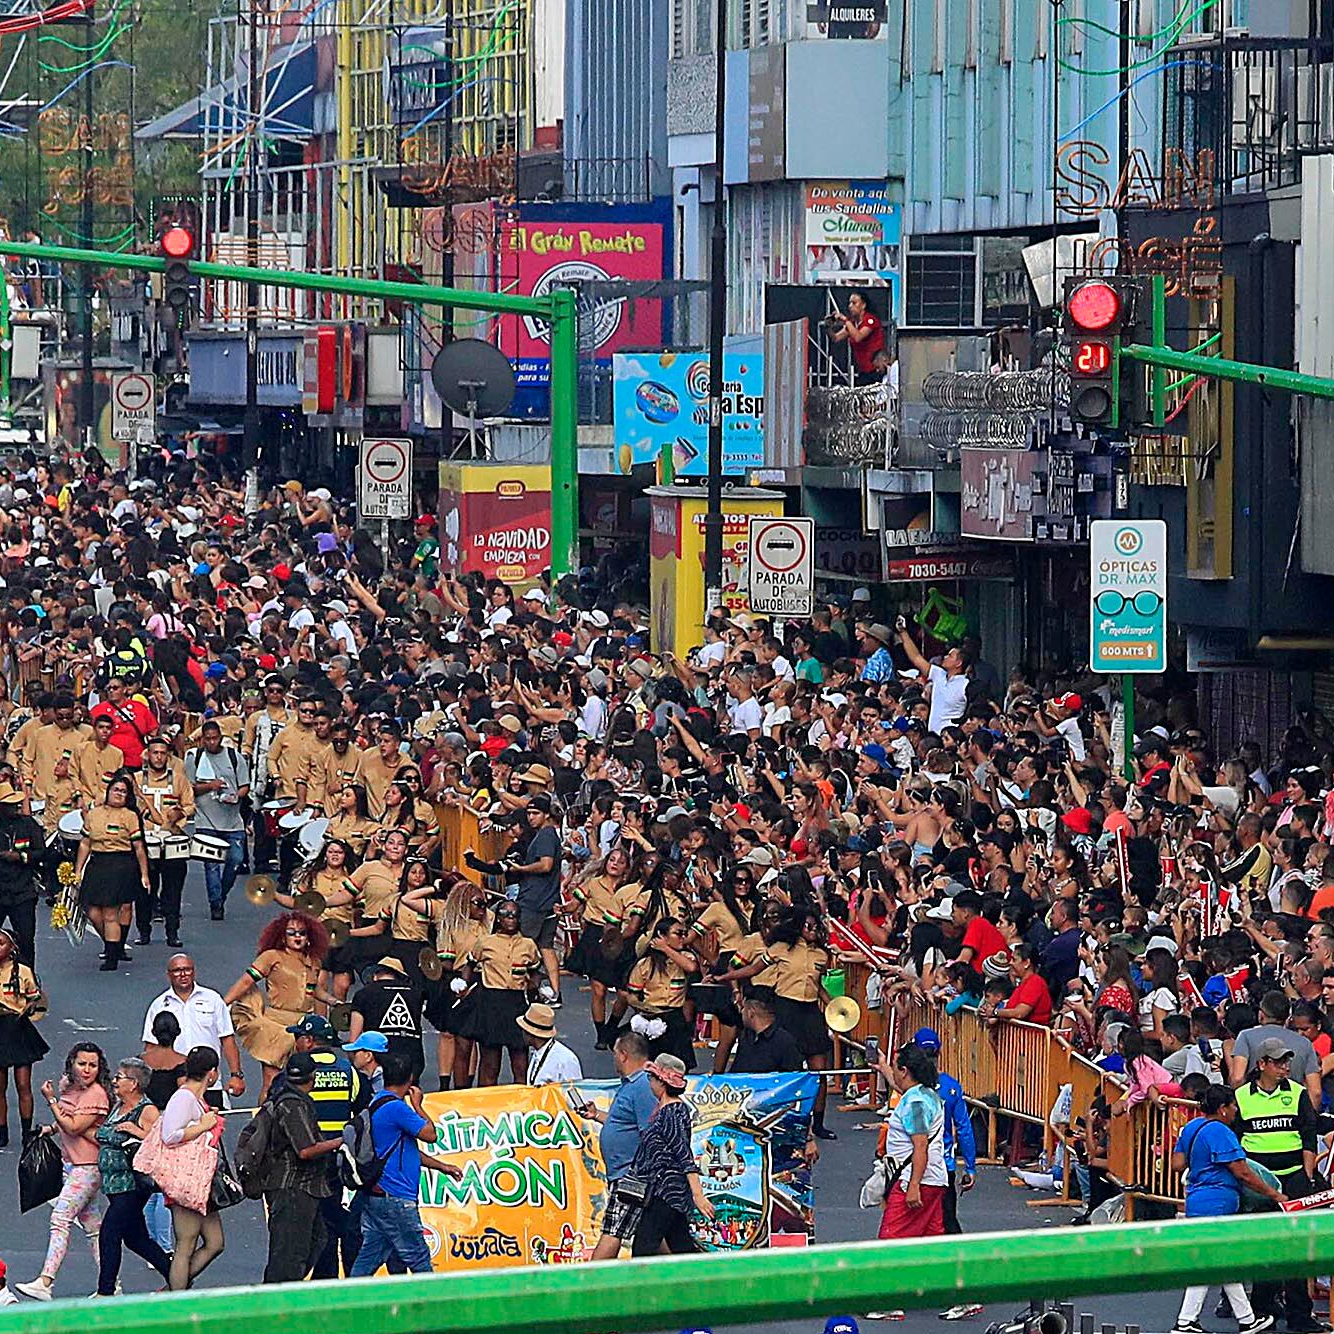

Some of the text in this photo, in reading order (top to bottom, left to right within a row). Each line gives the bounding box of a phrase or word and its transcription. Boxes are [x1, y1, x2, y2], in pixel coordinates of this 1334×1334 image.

[830, 8, 875, 21] ALQUILERES
[1056, 141, 1215, 216] SAN
[811, 187, 828, 198] De
[832, 188, 864, 198] venta
[812, 204, 832, 213] tus
[578, 229, 647, 256] Remate
[1078, 345, 1104, 369] 21
[117, 410, 149, 419] PARADA
[367, 482, 403, 493] PARADA
[483, 550, 527, 564] EMPIEZA
[1099, 558, 1158, 573] ÓPTICAS
[756, 572, 805, 585] PARADA
[1099, 573, 1157, 585] DR. MAX
[1101, 647, 1144, 656] 600 MTS
[315, 1071, 348, 1079] OLICIA
[1251, 1117, 1293, 1130] SECURITY
